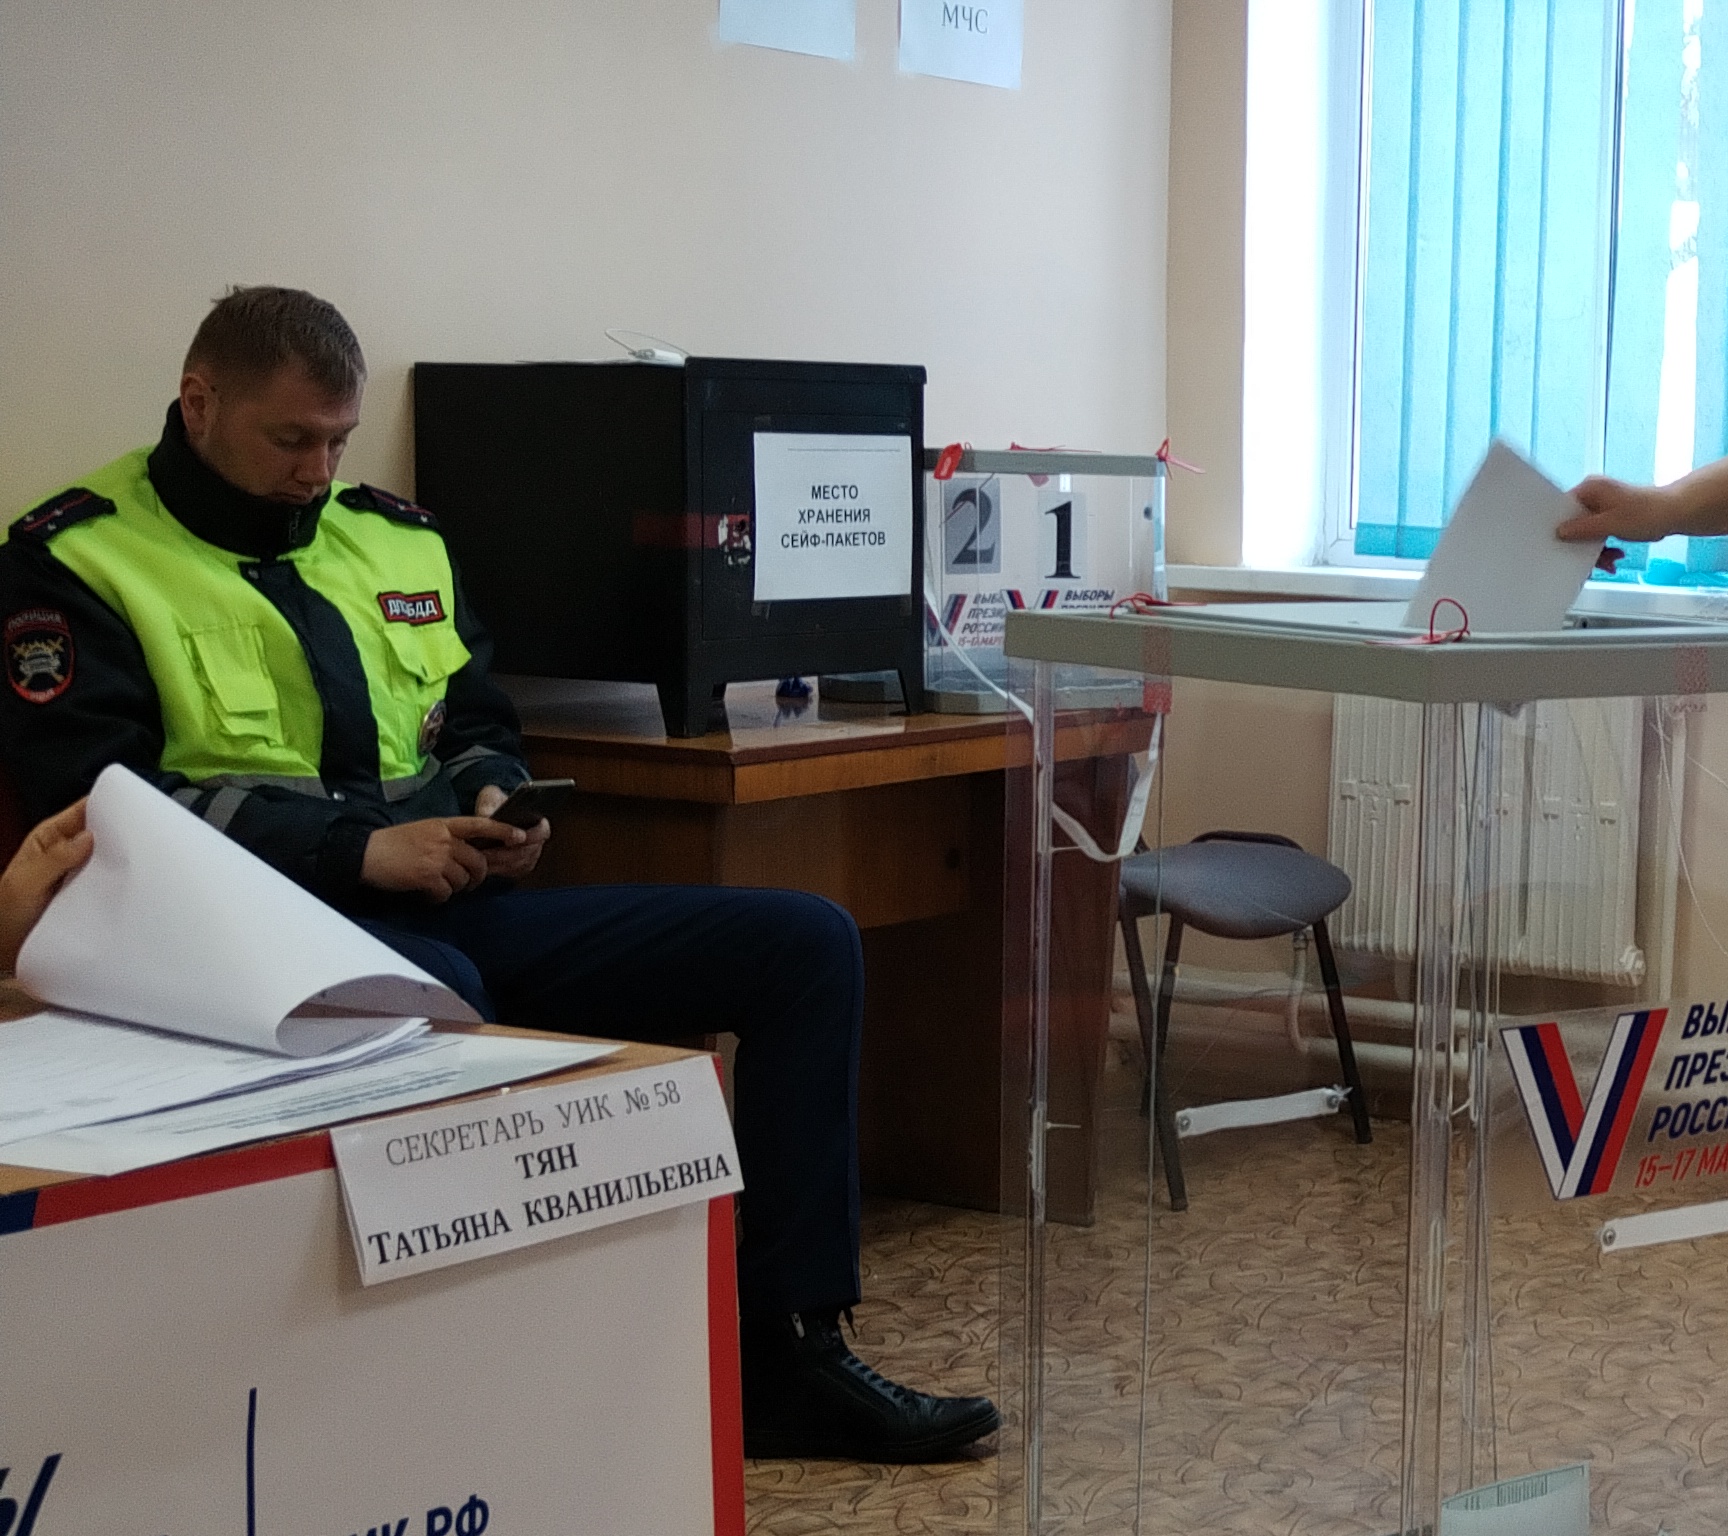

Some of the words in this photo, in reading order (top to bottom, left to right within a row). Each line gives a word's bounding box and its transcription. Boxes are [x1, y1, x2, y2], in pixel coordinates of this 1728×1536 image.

[941, 2, 989, 34] МЧС
[811, 484, 859, 500] МЕСТО
[798, 508, 871, 524] ХРАНЕНИЯ
[951, 487, 996, 564] 2
[781, 530, 886, 549] СЕЙФ-ПАКЕТОВ
[1044, 500, 1082, 580] 1
[1064, 590, 1116, 601] ВЫБОРЫ
[385, 1109, 544, 1167] СЕКРЕТАРЬ
[555, 1094, 615, 1129] УИК
[623, 1086, 650, 1115] №
[653, 1079, 681, 1108] 58
[515, 1142, 580, 1180] ТЯН
[368, 1207, 513, 1265] ТАТЬЯНА
[522, 1153, 733, 1228] КВАНИЛЬЕВНА
